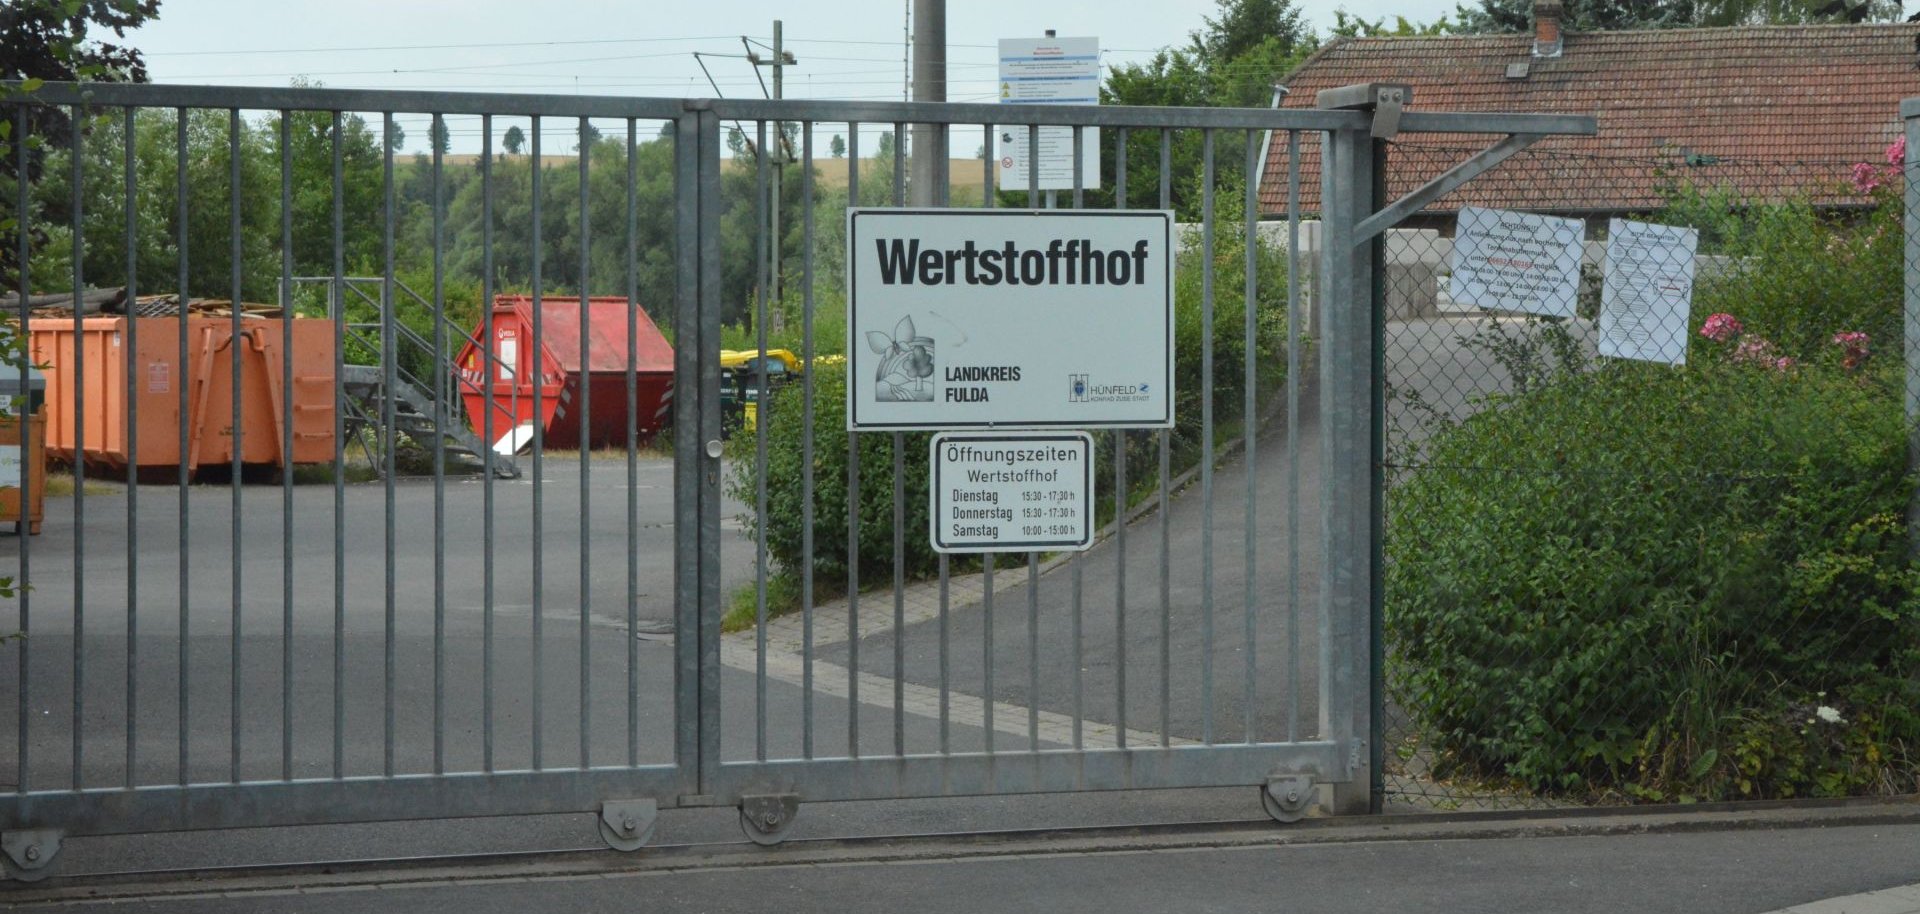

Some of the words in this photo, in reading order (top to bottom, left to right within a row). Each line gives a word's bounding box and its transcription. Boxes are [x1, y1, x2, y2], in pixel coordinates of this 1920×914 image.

[875, 238, 1149, 286] Wertstoffhof
[945, 365, 1021, 382] LANDKREIS
[945, 387, 989, 403] FULDA
[1090, 384, 1137, 395] HÜNFELD
[947, 444, 1077, 466] Öffnungszeiten
[967, 469, 1059, 483] Wertstoffhof
[952, 489, 998, 504] Dienstag
[1022, 491, 1042, 501] 15:30
[1048, 490, 1069, 501] 17:30
[952, 506, 1013, 522] Donnerstag
[1022, 508, 1042, 518] 15:30
[1049, 507, 1069, 518] 17:30
[952, 523, 998, 539] Samstag
[1022, 525, 1042, 536] 10:00
[1049, 525, 1069, 535] 15:00
